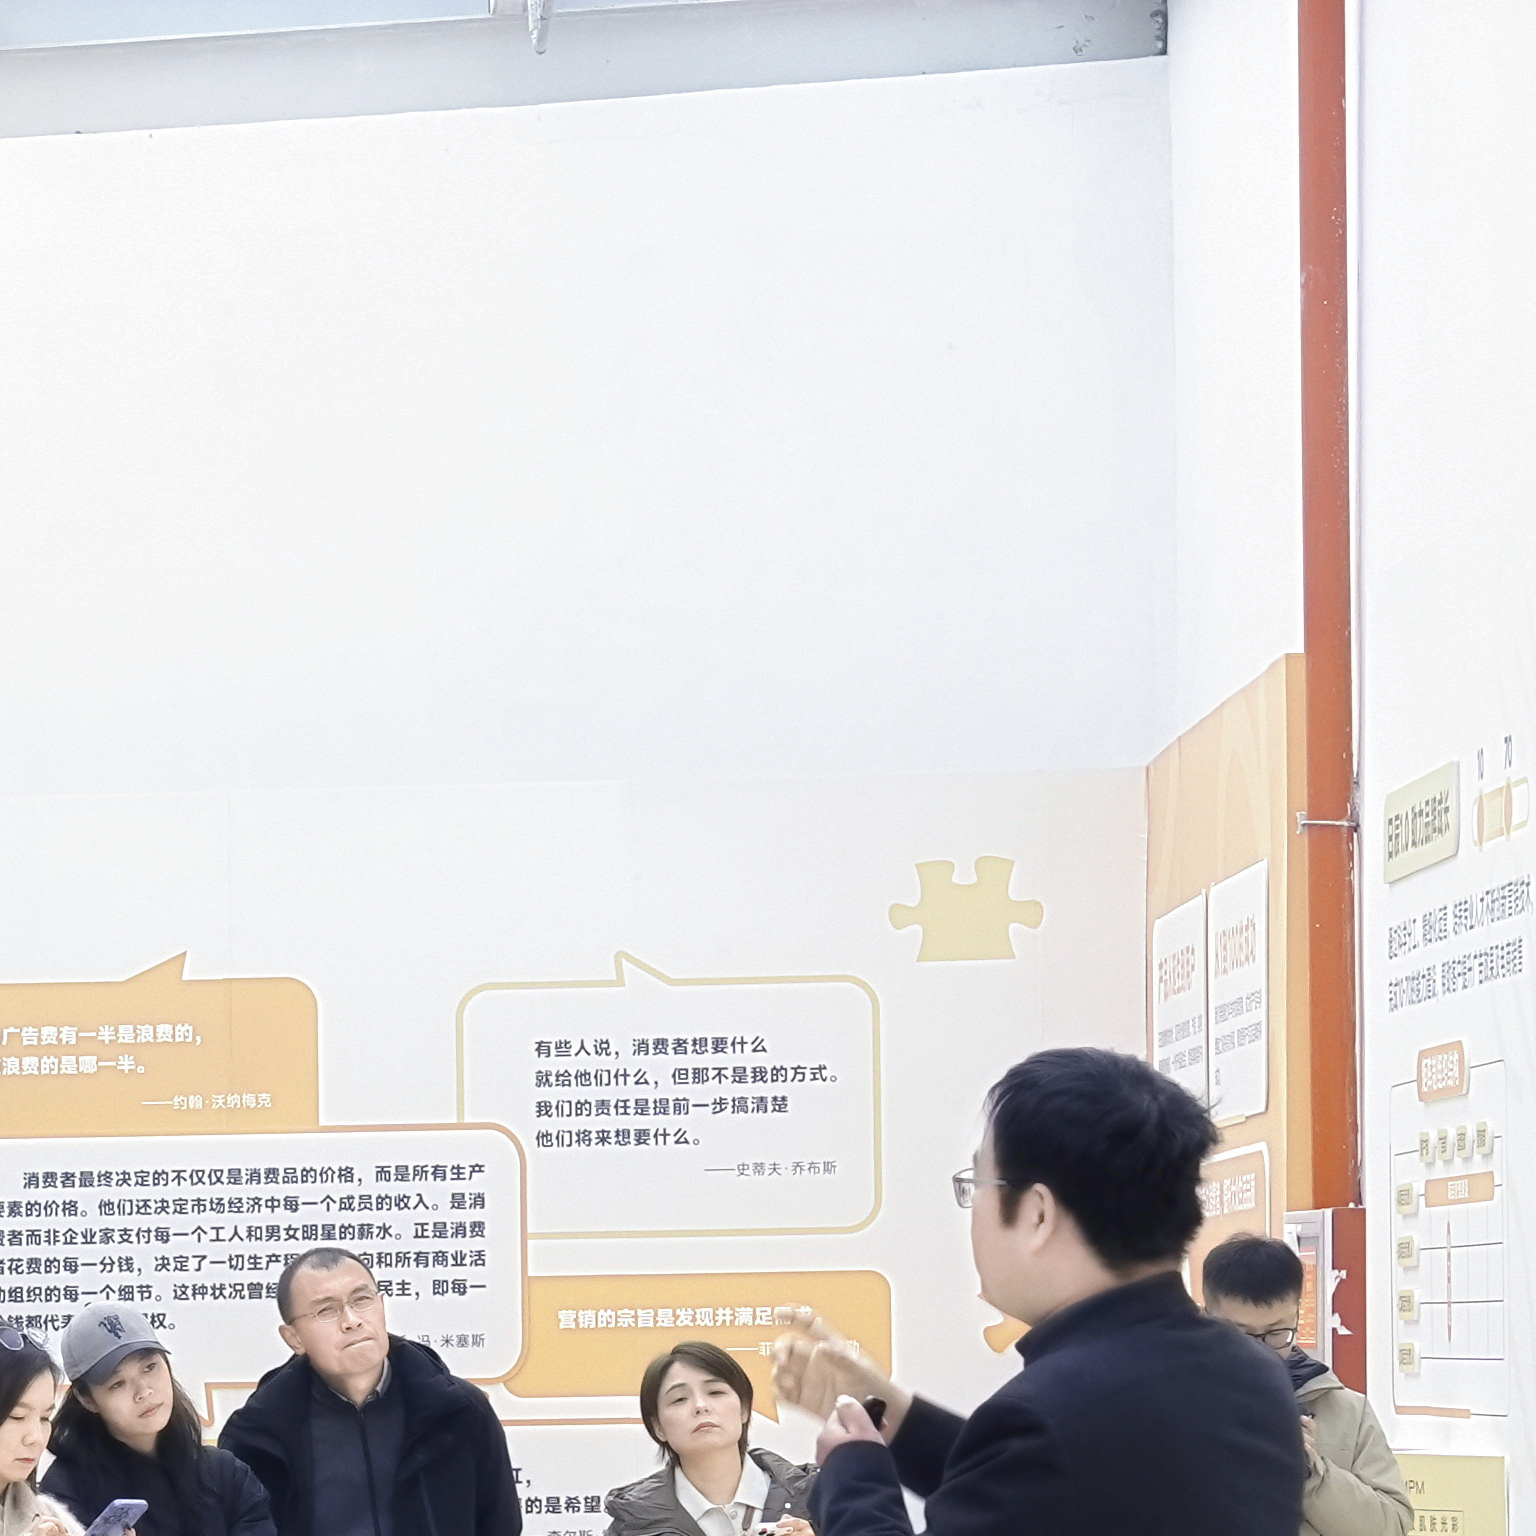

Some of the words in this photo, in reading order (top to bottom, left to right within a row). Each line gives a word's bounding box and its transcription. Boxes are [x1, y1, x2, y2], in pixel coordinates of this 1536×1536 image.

[534, 1036, 768, 1058] 有些人说，消费者想要什么
[535, 1064, 838, 1088] 就给他们什么，但那不是我的方式。
[535, 1095, 789, 1118] 我们的责任是提前一步搞清楚
[535, 1128, 701, 1148] 他们将来想要什么。
[23, 1164, 485, 1189] 消费者最终决定的不仅仅是消费品的价格，而是所有生产
